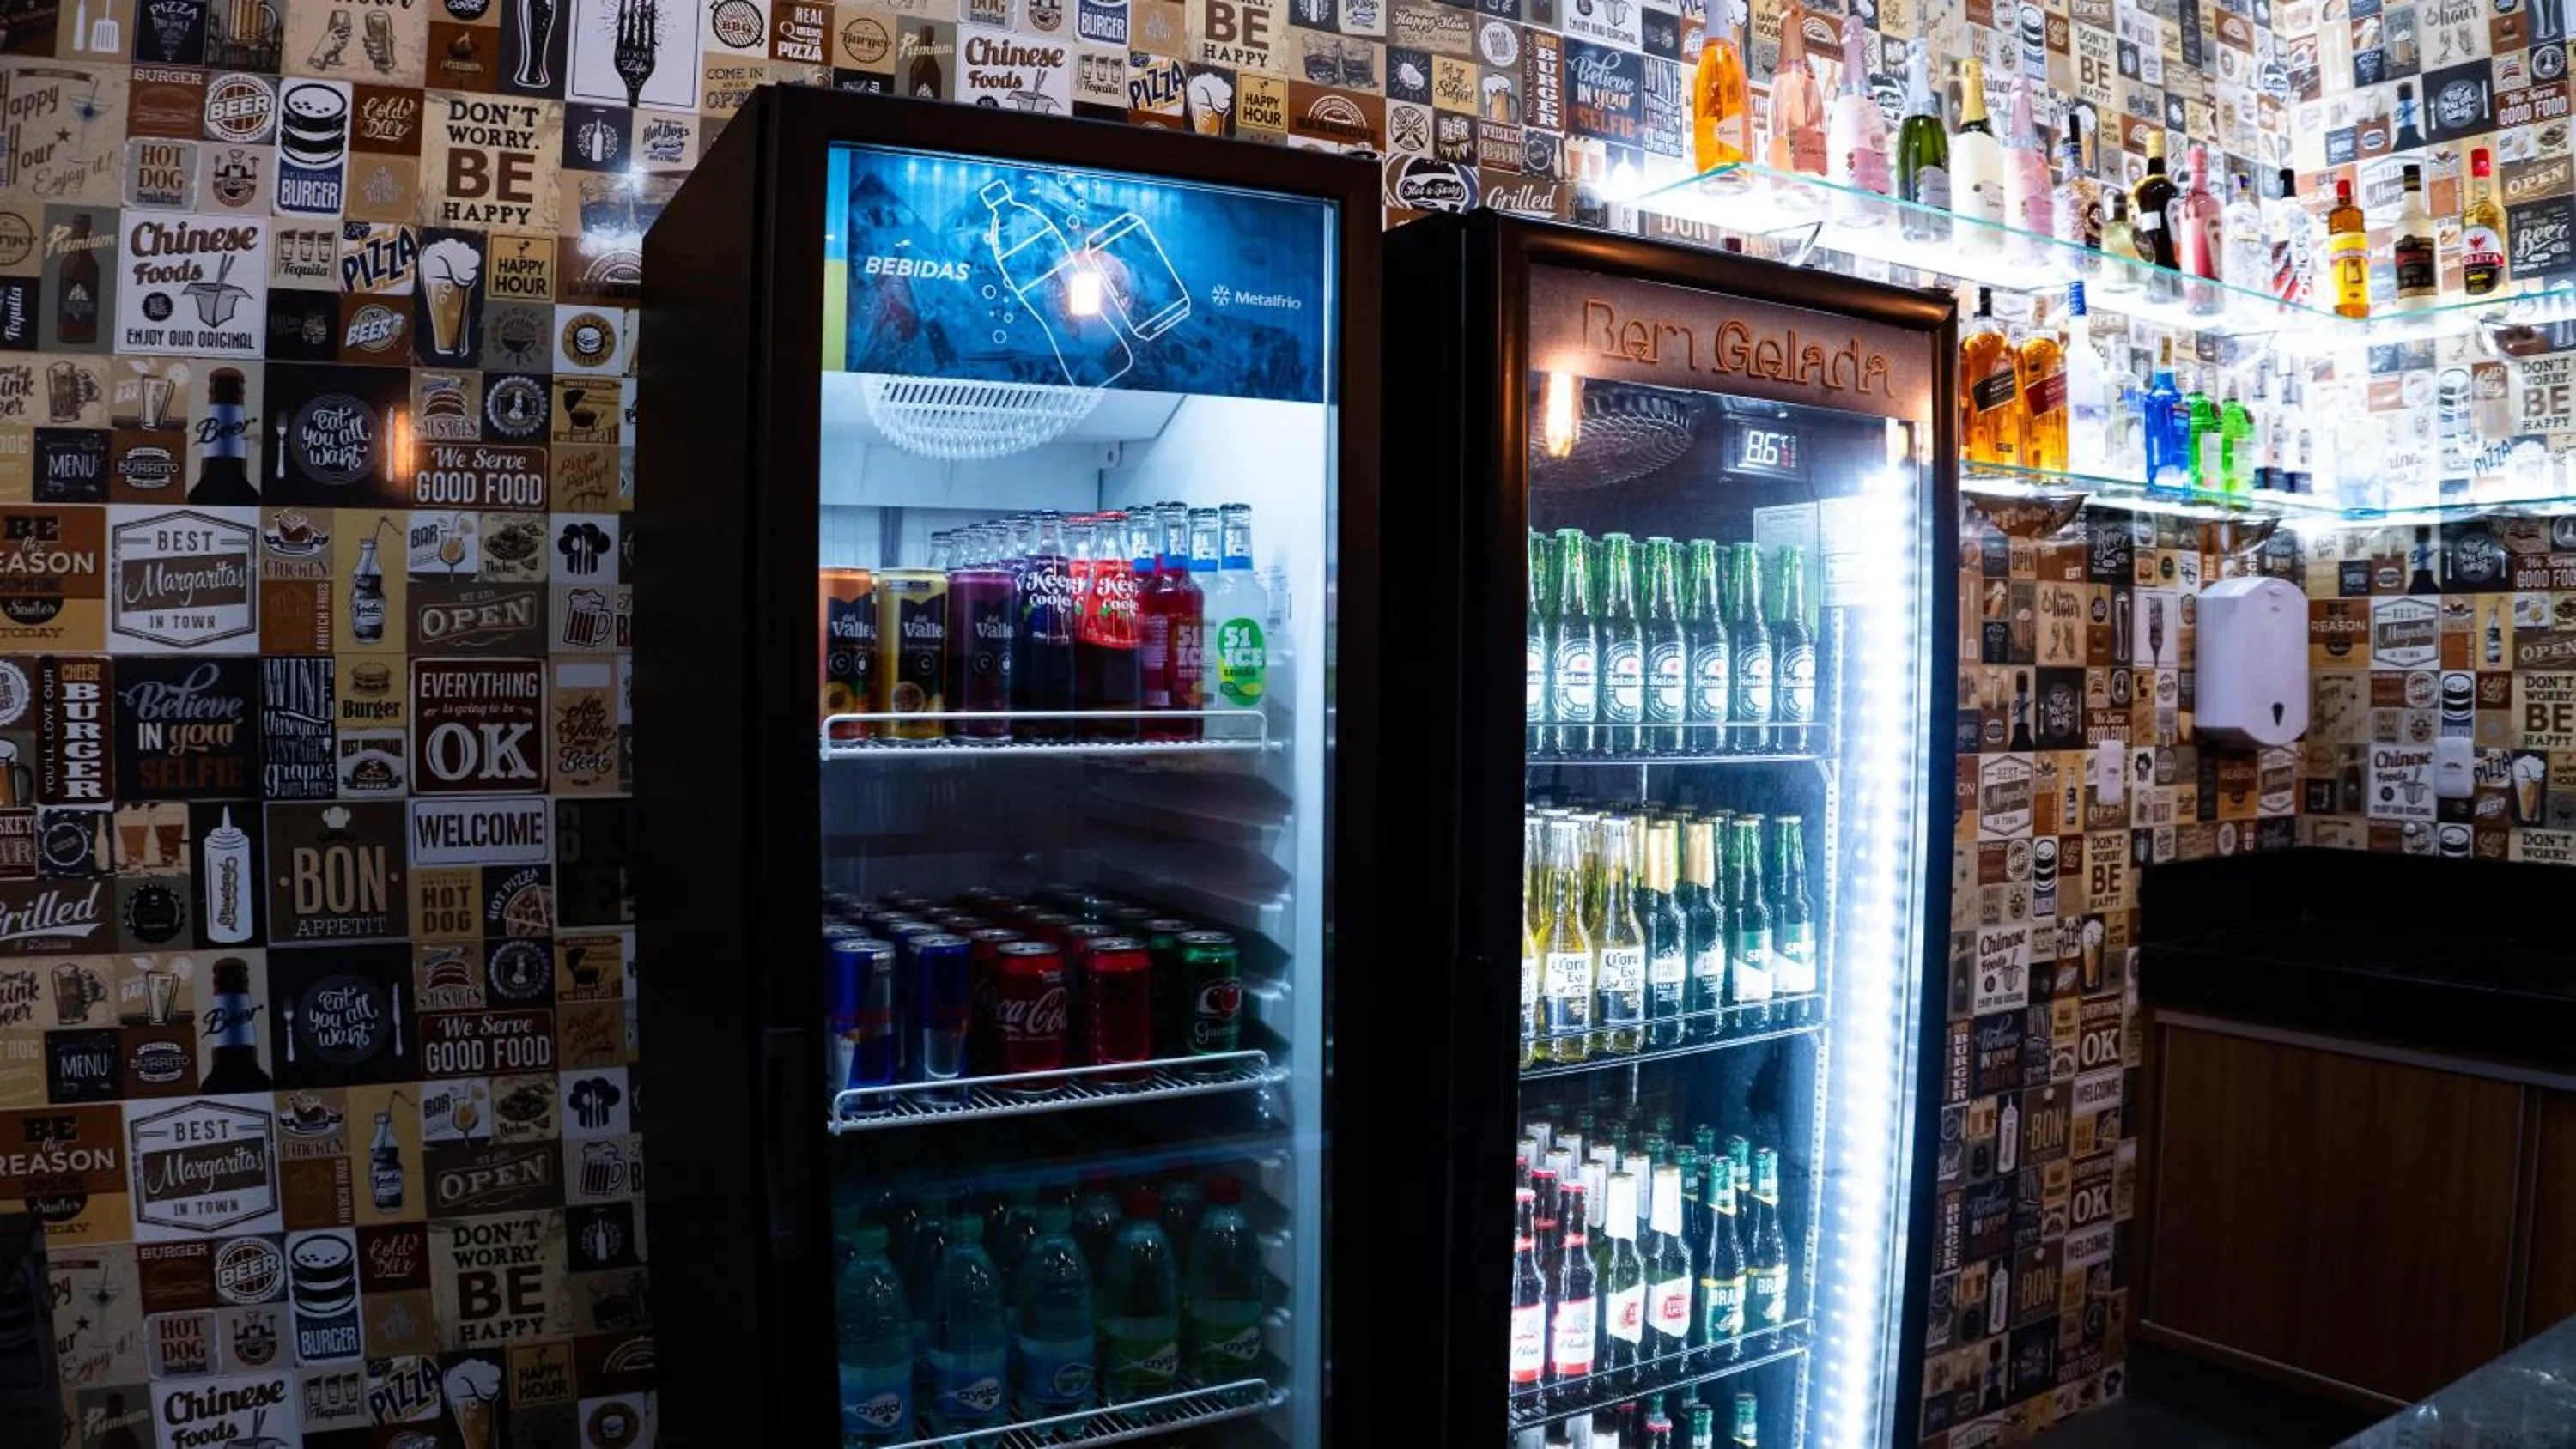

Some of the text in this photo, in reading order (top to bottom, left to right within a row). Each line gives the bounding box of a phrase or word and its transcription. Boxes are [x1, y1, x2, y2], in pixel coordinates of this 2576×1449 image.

[722, 21, 751, 33] BBQ
[795, 7, 824, 25] REAL
[1081, 14, 1125, 41] BURGER
[1206, 2, 1270, 50] BE
[1393, 10, 1436, 32] Happy
[778, 41, 823, 61] PIZZA
[898, 32, 956, 60] Premium
[964, 37, 1064, 68] Chinese
[1203, 43, 1267, 68] HAPPY
[134, 69, 203, 85] BURGER
[706, 68, 764, 79] COME IN
[968, 71, 1024, 90] Foods
[1566, 52, 1635, 91] Believe
[2081, 55, 2111, 88] BE
[1130, 58, 1184, 111] PIZZA
[1577, 82, 1635, 111] IN your
[208, 94, 271, 121] BEER
[1245, 93, 1280, 108] HAPPY
[2500, 96, 2567, 125] GOOD FOOD
[449, 100, 539, 127] DON'T
[1243, 107, 1282, 126] HOUR
[1578, 106, 1636, 138] SELFIE
[1442, 118, 1468, 140] BEER
[6, 125, 55, 187] Hour
[140, 145, 185, 167] HOT
[137, 168, 184, 189] DOG
[446, 149, 537, 203] BE
[2507, 163, 2566, 194] OPEN
[281, 179, 338, 209] BURGER
[1486, 185, 1557, 210] Grilled
[443, 202, 532, 224] HAPPY
[45, 224, 116, 255] Premium
[131, 221, 258, 257] Chinese
[2516, 224, 2569, 258] Beer
[282, 262, 328, 277] Tequila
[343, 225, 417, 292] PIZZA
[498, 258, 546, 275] HAPPY
[865, 257, 970, 282] BEBIDAS
[133, 260, 203, 285] Foods
[495, 276, 547, 295] HOUR
[1235, 290, 1301, 310] Metalfrio
[3, 286, 22, 341] Tequila
[127, 329, 255, 349] ENJOY OUR ORIGINAL
[1582, 299, 1895, 397] Bem Gelada
[2523, 358, 2569, 373] DON'T
[2523, 386, 2570, 416] BE
[313, 407, 352, 430] eat
[2523, 417, 2570, 429] HAPPY
[196, 418, 257, 446] Beer
[302, 415, 371, 448] you all
[48, 453, 97, 478] MENU
[118, 462, 179, 474] BURRITO
[310, 447, 368, 470] want
[434, 447, 526, 469] We Serve
[416, 472, 542, 505] GOOD FOOD
[157, 531, 213, 551] BEST
[410, 524, 438, 548] BAR
[2013, 549, 2034, 569] OPEN
[124, 562, 245, 605] Margaritas
[2517, 570, 2549, 589] GOOD
[150, 616, 216, 628] IN TOWN
[422, 598, 530, 638] OPEN
[831, 620, 871, 638] Valle
[904, 621, 944, 639] Valle
[976, 621, 1015, 640] Valle
[1178, 625, 1200, 646] 51
[1224, 626, 1251, 647] 51
[1224, 647, 1265, 668] ICE
[62, 665, 100, 681] CHEESE
[421, 671, 538, 699] EVERYTHING
[2525, 676, 2573, 688] DON'T
[118, 663, 243, 720] Believe
[343, 700, 401, 720] Burger
[454, 703, 485, 718] going
[2525, 704, 2573, 733] BE
[62, 683, 102, 798] BURGER
[138, 718, 243, 755] IN your
[2524, 735, 2572, 746] HAPPY
[426, 722, 537, 781] OK
[2374, 750, 2431, 769] Chinese
[138, 757, 245, 788] SELFIE
[417, 812, 544, 849] WELCOME
[2092, 834, 2123, 849] DON'T
[2522, 833, 2572, 846] DON'T
[293, 846, 386, 916] BON
[2091, 864, 2121, 894] BE
[422, 887, 472, 908] HOT
[488, 868, 540, 921] HOT PIZZA
[295, 916, 386, 937] APPETIT
[422, 910, 471, 934] DOG
[1979, 928, 2026, 955] Chinese
[203, 1003, 264, 1036] Beer
[439, 1015, 533, 1037] We Serve
[319, 1025, 374, 1048] want
[2081, 1029, 2119, 1064] OK
[426, 1035, 550, 1072] GOOD FOOD
[61, 1055, 108, 1078] MENU
[2076, 1076, 2120, 1105] WELCOME
[174, 1119, 229, 1141] BEST
[2031, 1106, 2065, 1152] BON
[147, 1146, 264, 1194] Margaritas
[440, 1153, 546, 1199] OPEN
[173, 1199, 239, 1216] IN TOWN
[2073, 1187, 2110, 1223] OK
[453, 1220, 541, 1247] DON'T
[140, 1245, 208, 1259] BURGER
[2066, 1234, 2111, 1261] WELCOME
[218, 1258, 279, 1285] BEER
[459, 1266, 544, 1320] BE
[2021, 1265, 2055, 1312] BON
[160, 1318, 203, 1339] HOT
[459, 1316, 544, 1342] HAPPY
[161, 1341, 206, 1360] DOG
[301, 1325, 359, 1358] BURGER
[519, 1363, 565, 1379] HAPPY
[369, 1355, 440, 1424] PIZZA
[519, 1378, 569, 1398] HOUR
[163, 1379, 287, 1425] Chinese
[856, 1399, 902, 1420] crystal
[172, 1421, 239, 1449] Foods
